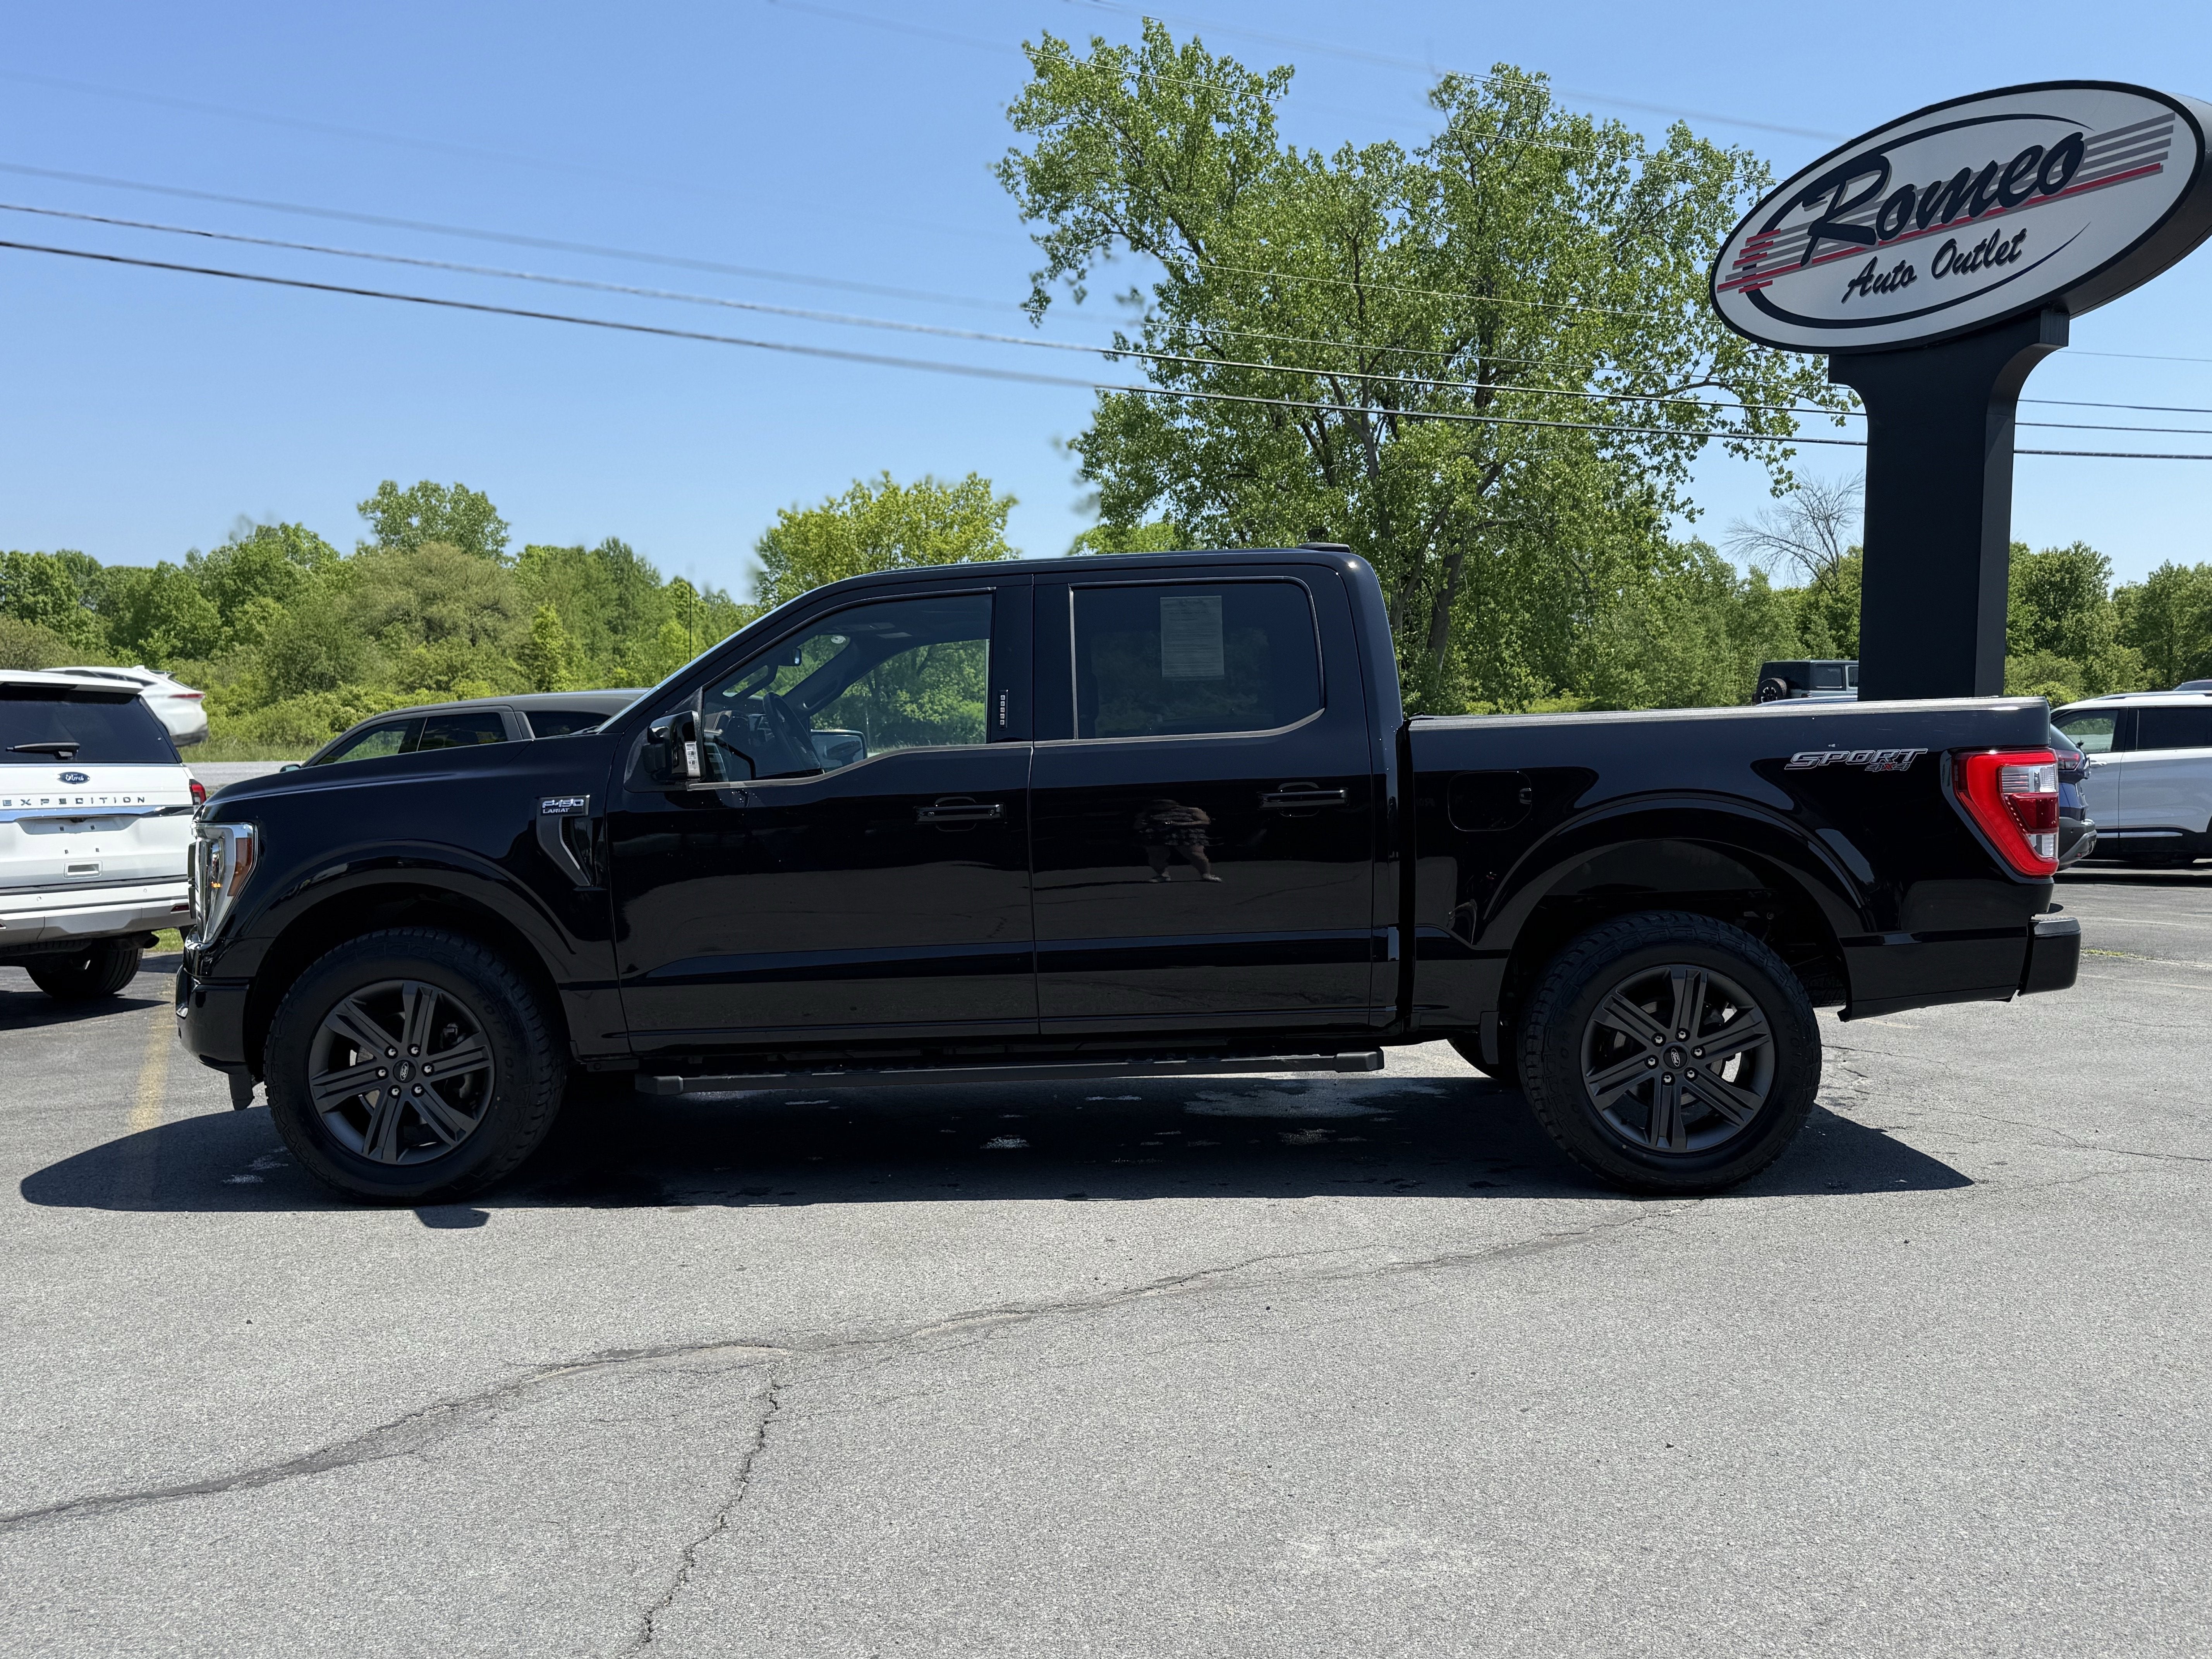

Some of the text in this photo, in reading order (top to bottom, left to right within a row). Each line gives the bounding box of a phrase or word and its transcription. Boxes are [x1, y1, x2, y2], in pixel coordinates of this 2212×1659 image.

[1801, 132, 2085, 267] Romeo
[1841, 228, 2027, 304] Auto Outlet
[1784, 748, 1929, 770] SPORT
[3, 797, 145, 806] EXPEDITION
[542, 799, 584, 808] F-150
